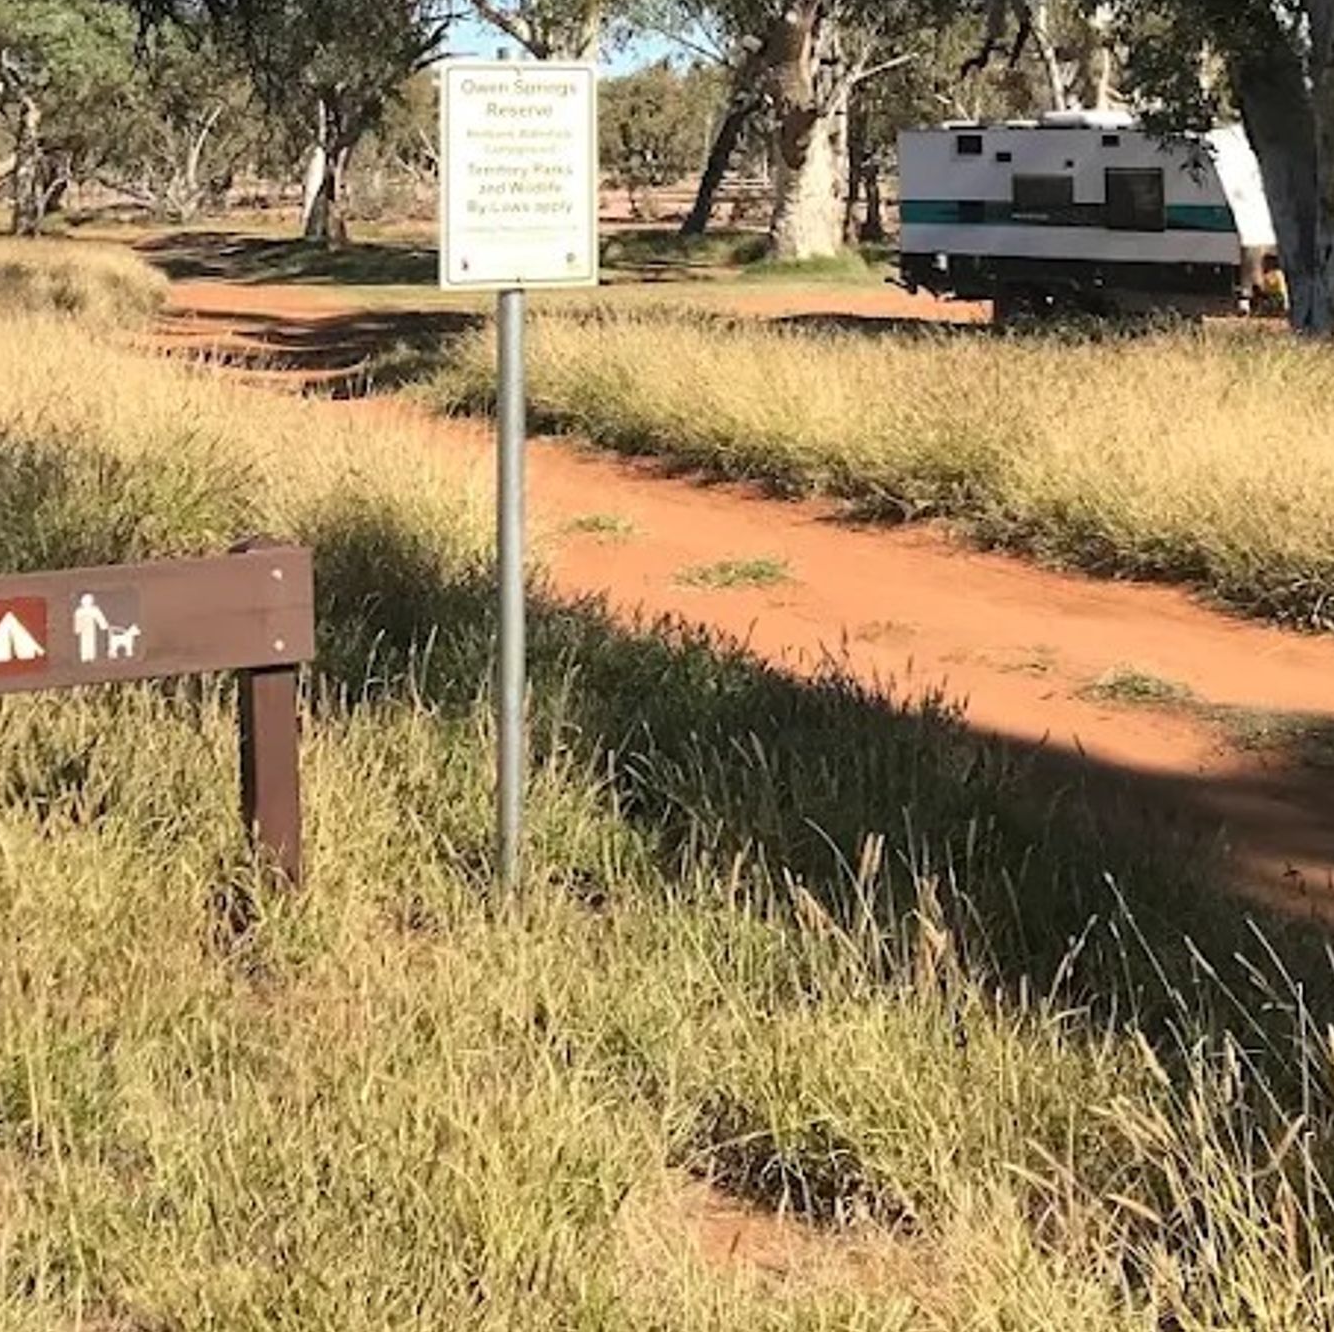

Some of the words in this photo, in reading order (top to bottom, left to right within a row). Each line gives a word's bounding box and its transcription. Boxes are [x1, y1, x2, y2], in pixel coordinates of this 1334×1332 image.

[460, 78, 509, 95] Owen
[513, 78, 578, 98] Springs
[486, 101, 554, 118] Reserve
[532, 162, 574, 176] Parks
[477, 181, 507, 195] and
[533, 200, 574, 216] apply
